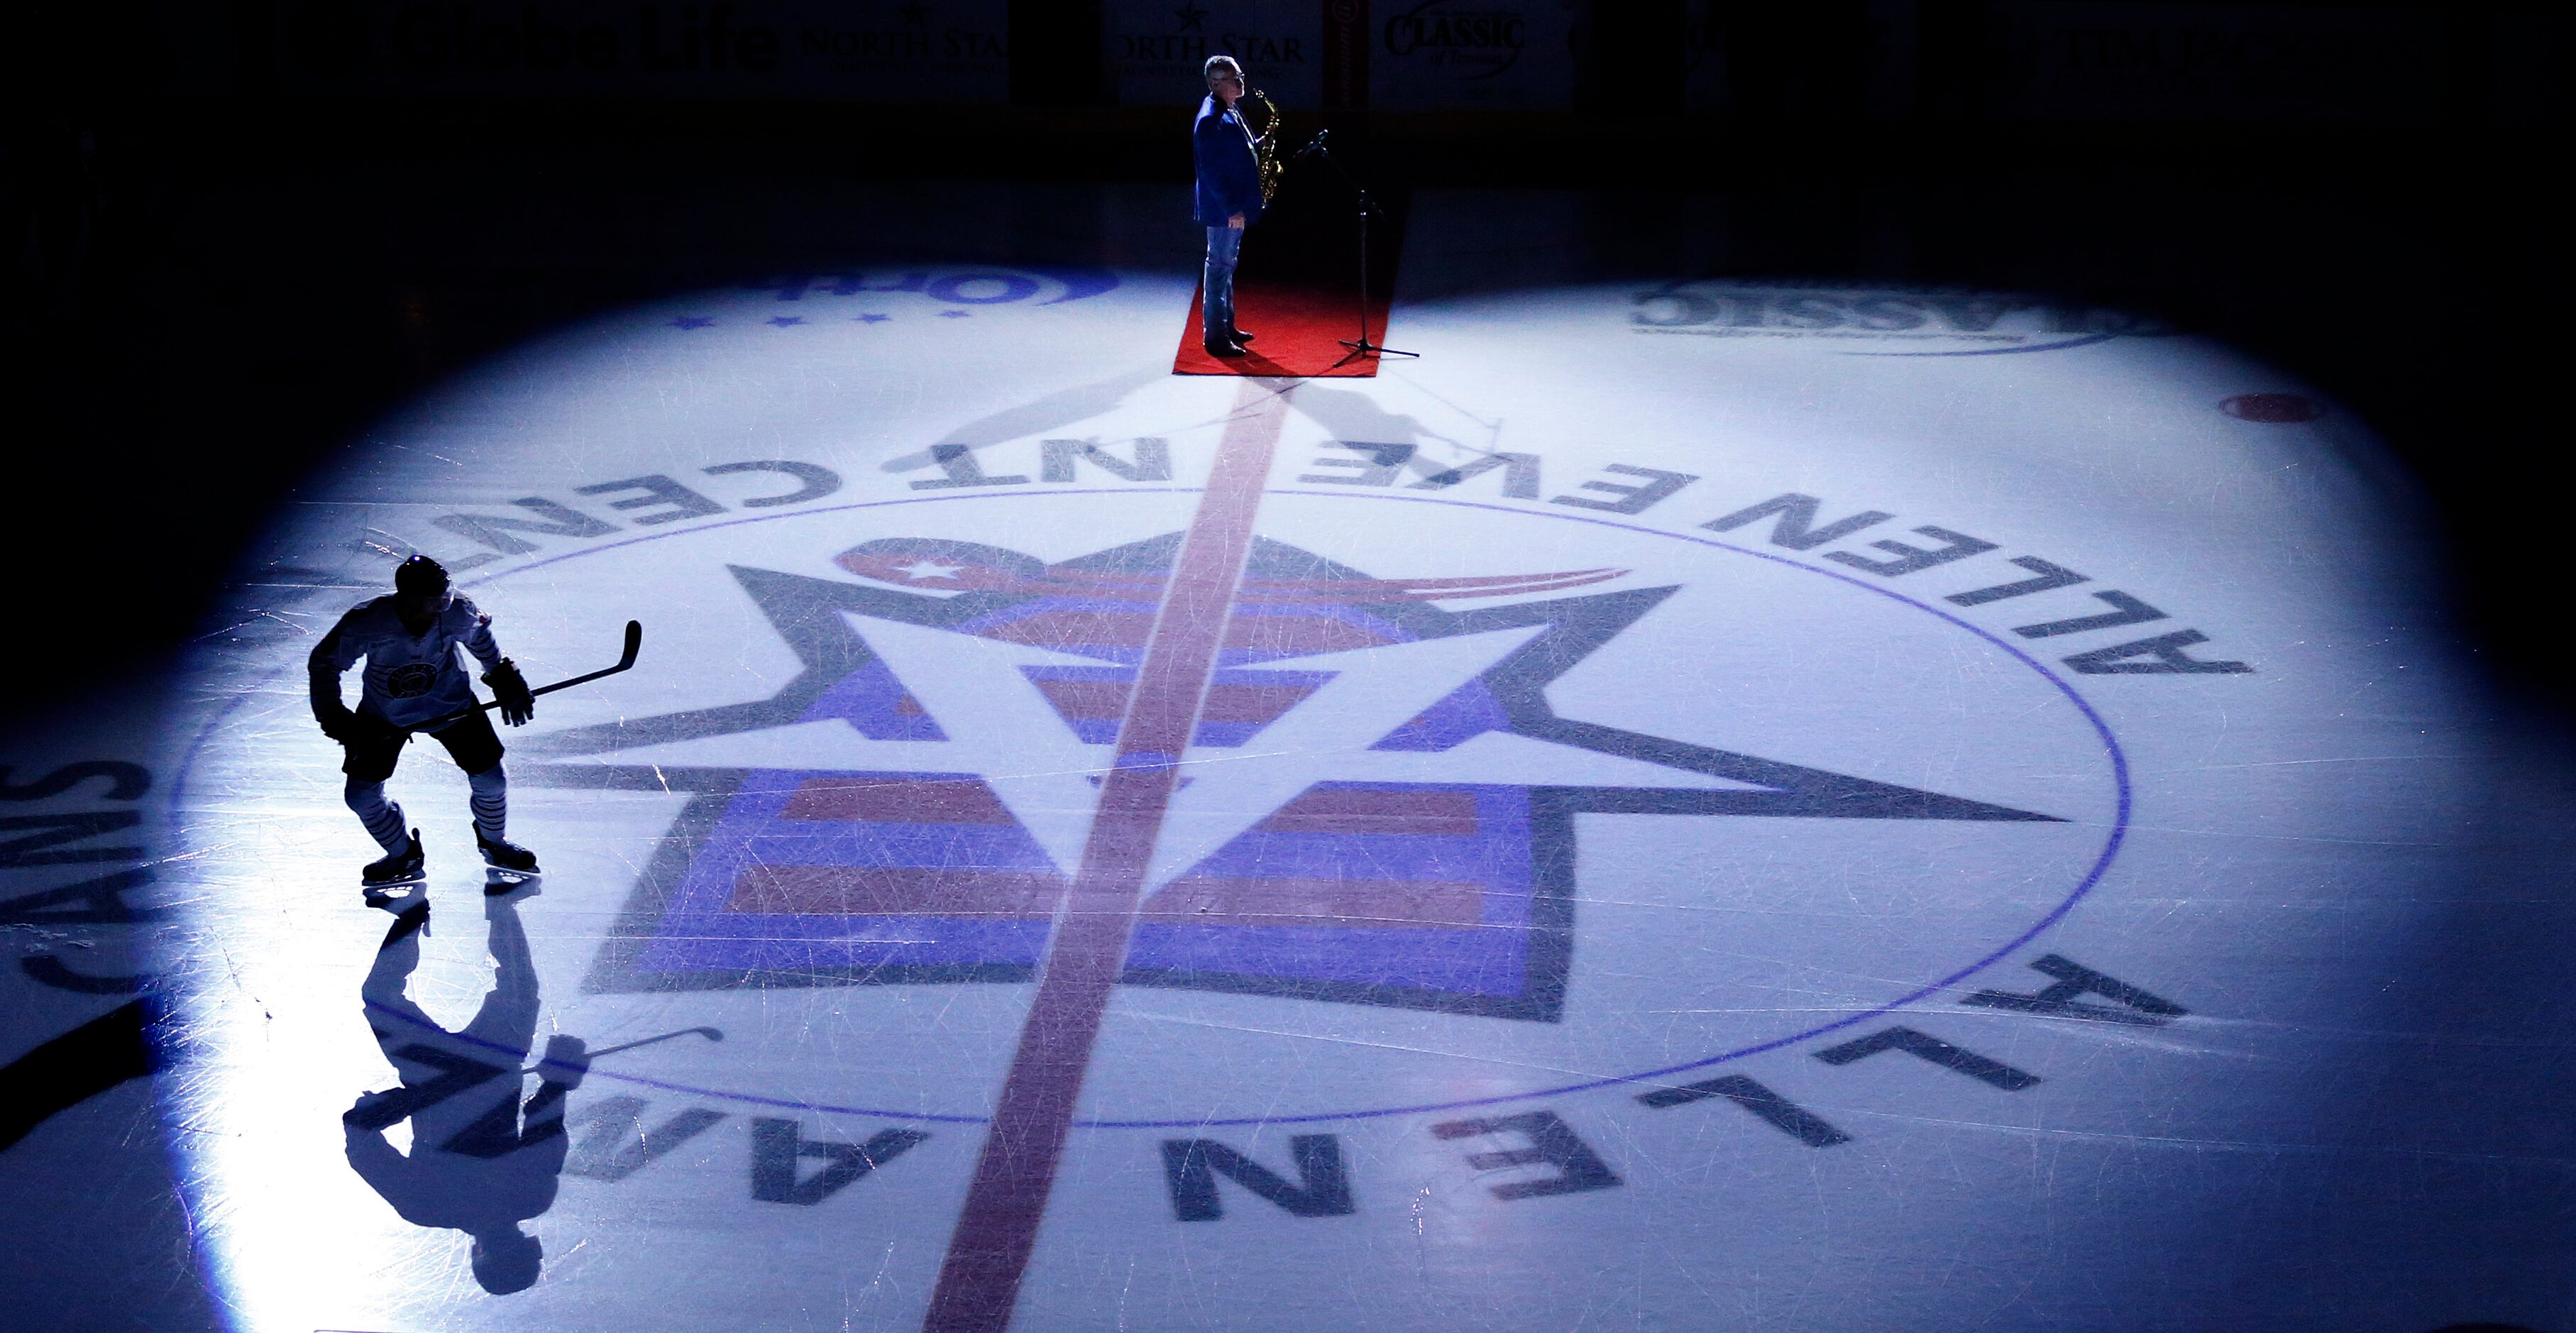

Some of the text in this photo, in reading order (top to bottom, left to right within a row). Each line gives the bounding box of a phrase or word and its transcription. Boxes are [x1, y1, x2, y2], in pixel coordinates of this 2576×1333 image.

[394, 2, 779, 72] Globe Life
[800, 26, 1008, 57] NORTH STA
[1117, 33, 1305, 62] ORTH STAR
[1384, 15, 1526, 56] CLASSIC
[1700, 491, 2257, 676] ALLEN
[1161, 953, 2190, 1222] ALLEN
